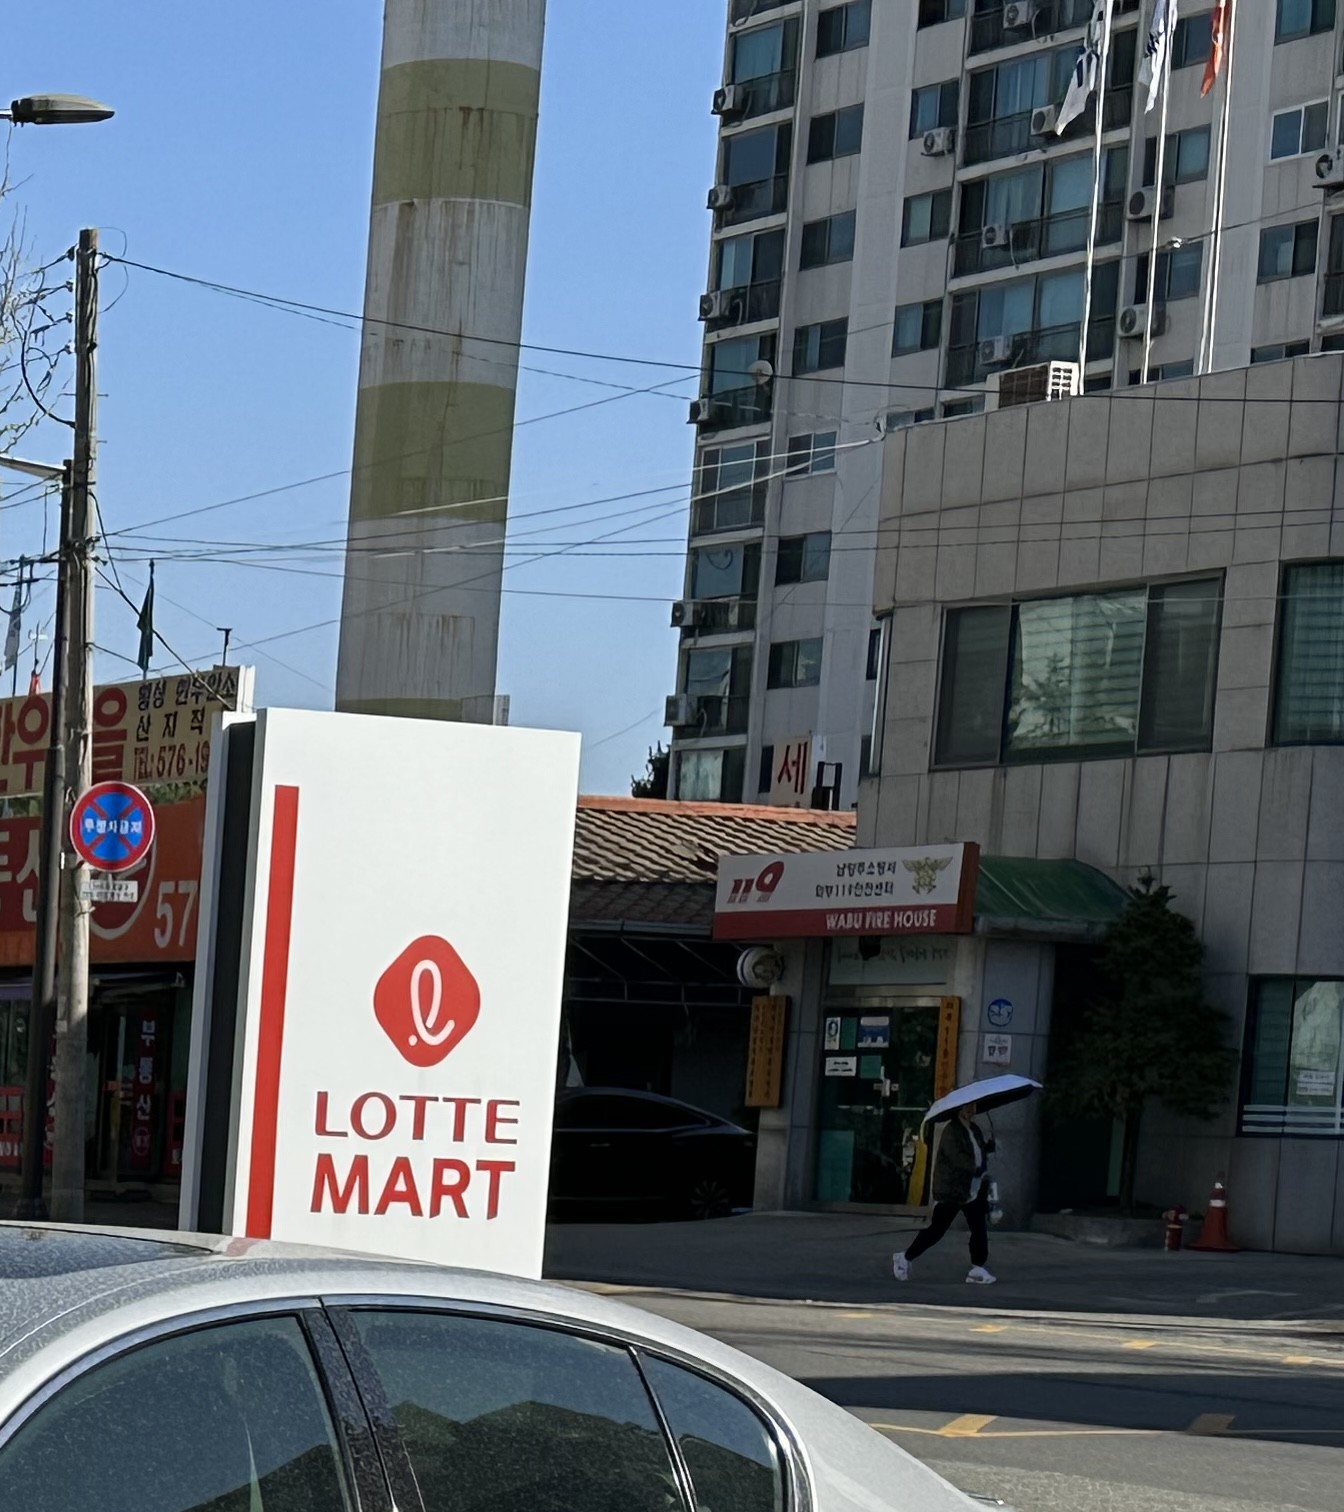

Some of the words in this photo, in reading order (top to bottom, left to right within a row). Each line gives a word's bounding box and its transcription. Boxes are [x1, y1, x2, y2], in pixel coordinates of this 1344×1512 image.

[727, 861, 785, 904] 119
[826, 913, 862, 931] WABU
[865, 911, 891, 929] FIRE
[894, 908, 937, 929] HOUSE
[314, 1091, 520, 1145] LOTTE
[310, 1152, 516, 1220] MART
